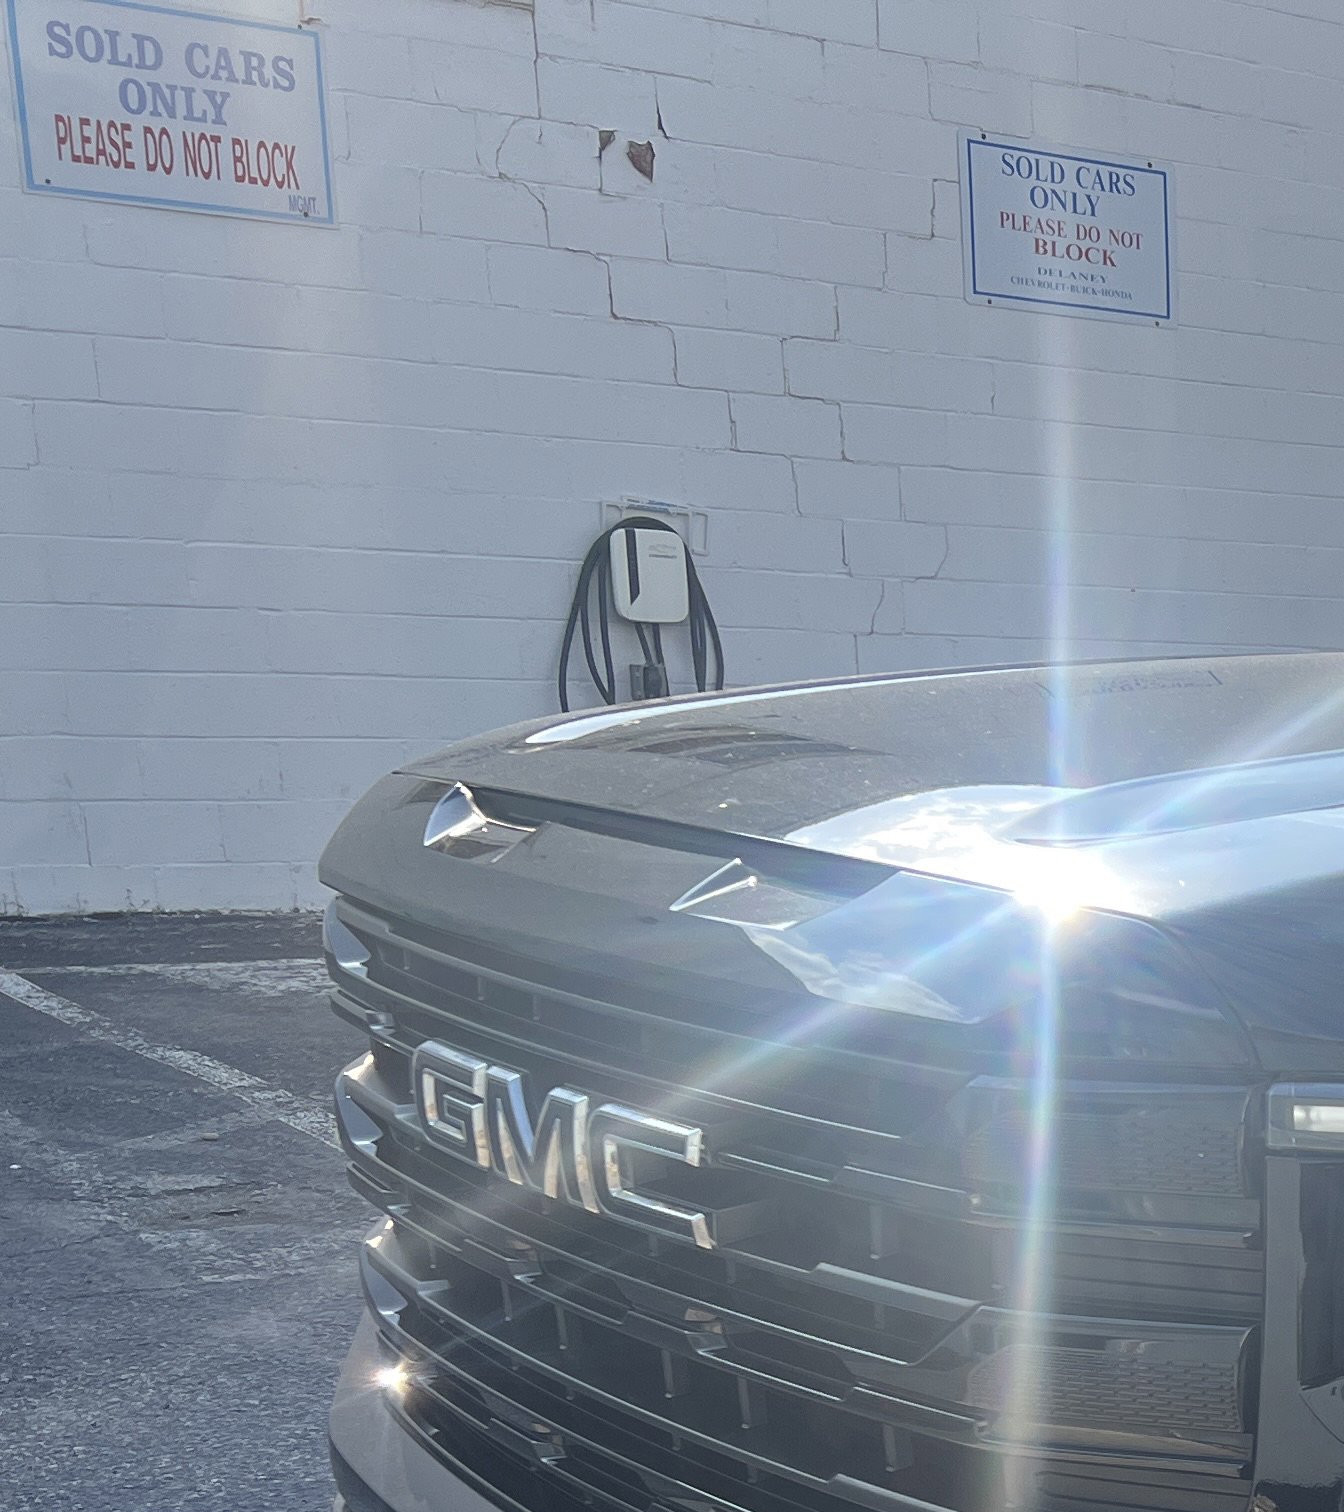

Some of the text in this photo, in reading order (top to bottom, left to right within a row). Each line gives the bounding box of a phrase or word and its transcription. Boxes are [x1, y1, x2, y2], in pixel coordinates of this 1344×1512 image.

[45, 20, 297, 92] SOLD CARS
[118, 77, 231, 126] ONLY
[54, 113, 301, 190] PLEASE DO NOT BLOCK
[1001, 152, 1137, 197] SOLD CARS
[1029, 184, 1101, 218] ONLY
[999, 210, 1144, 250] PLEASE DO NOT
[1032, 236, 1117, 268] BLOCK
[1037, 266, 1109, 285] DELANEY
[411, 1038, 718, 1250] GMC
